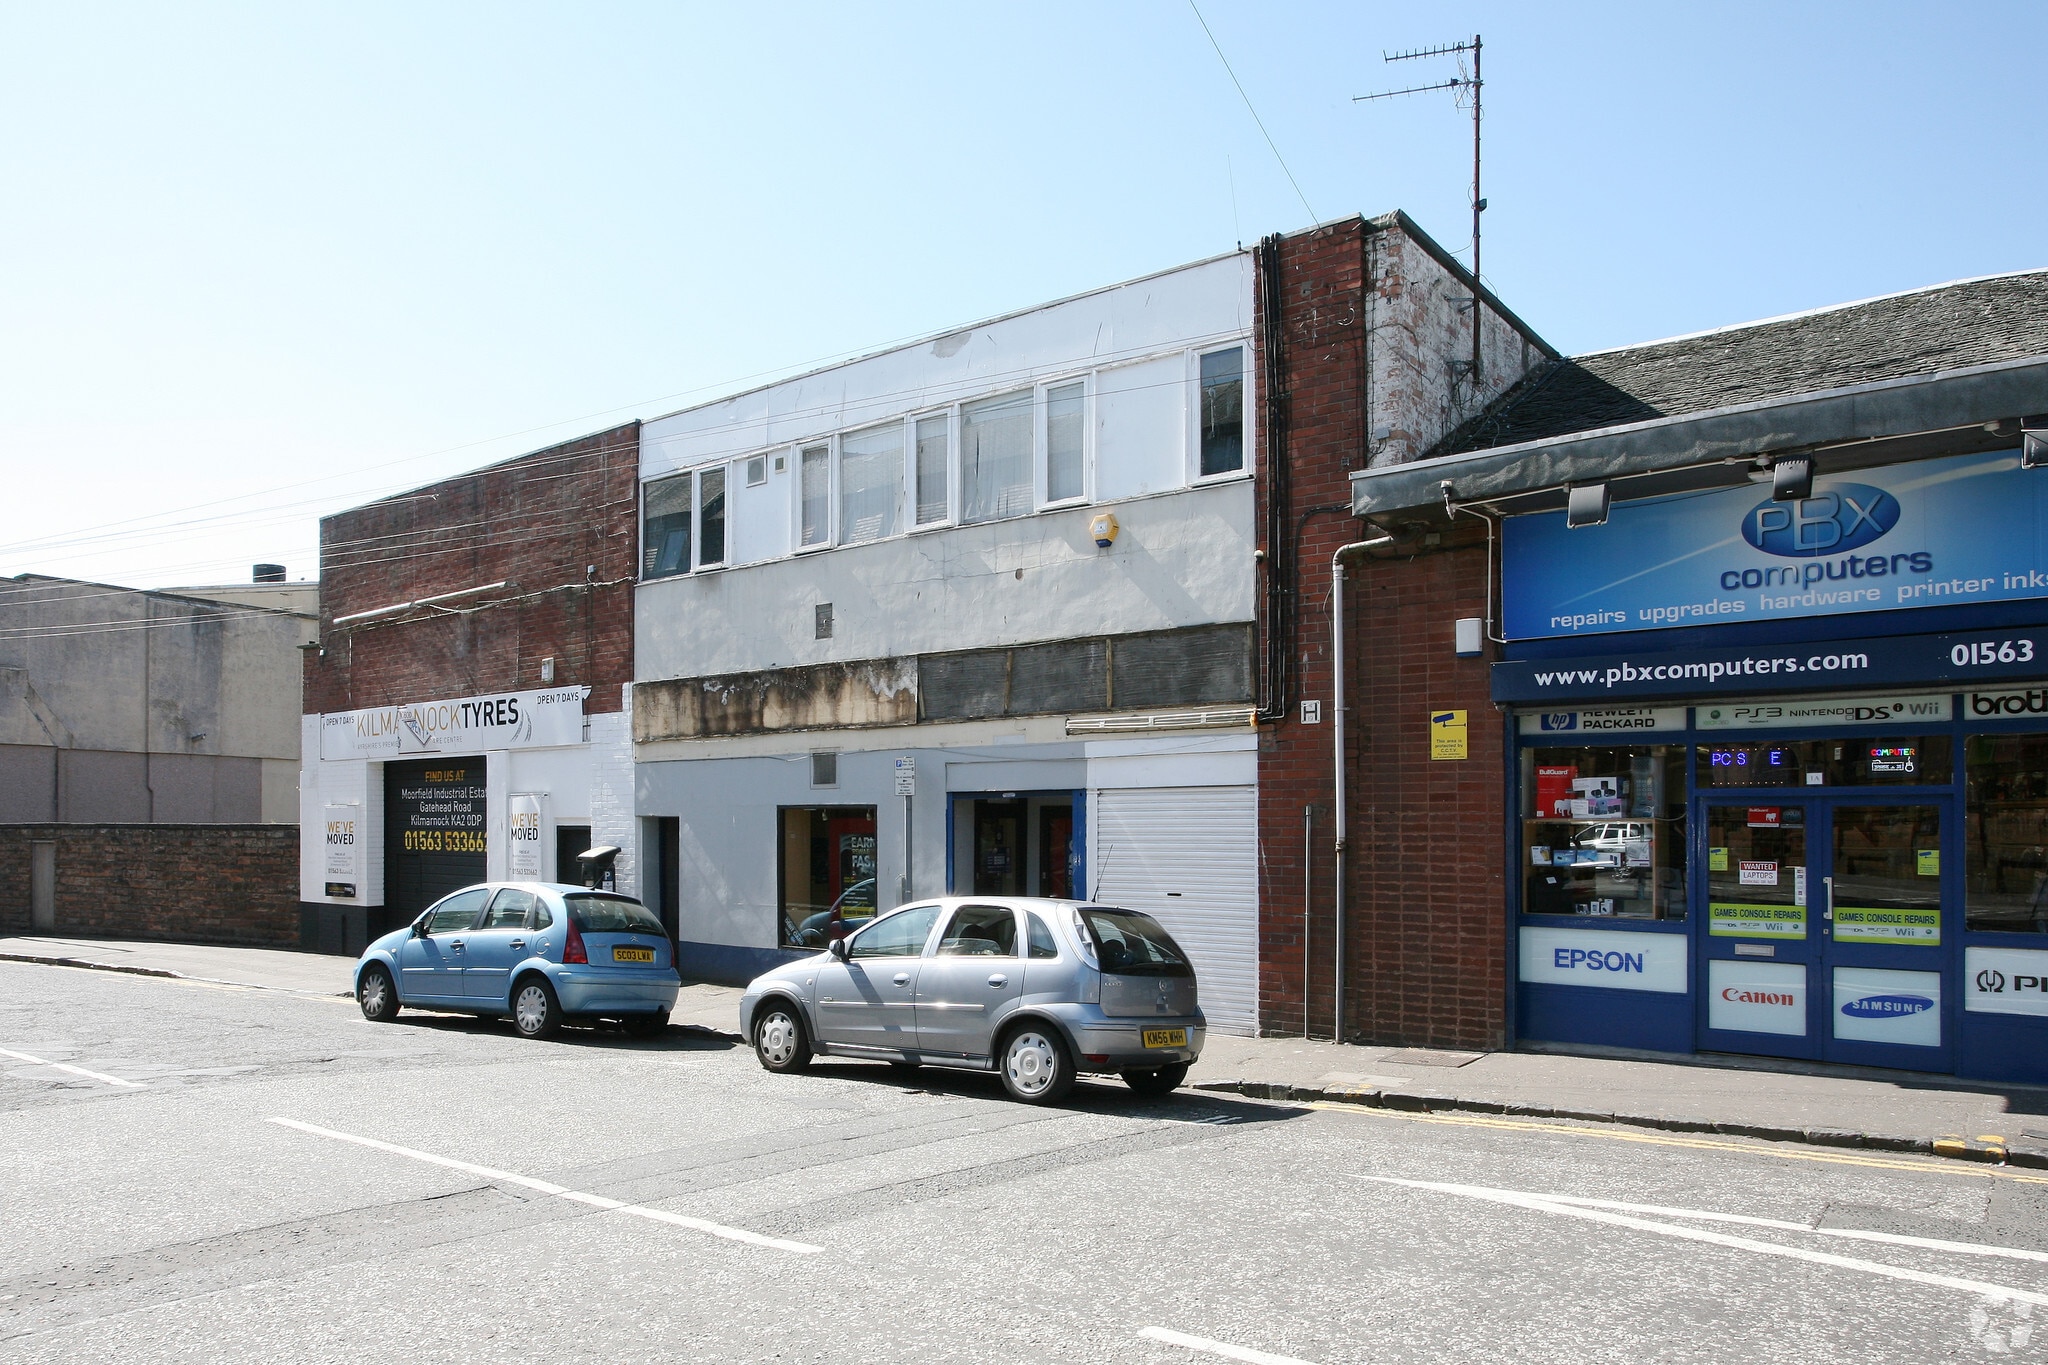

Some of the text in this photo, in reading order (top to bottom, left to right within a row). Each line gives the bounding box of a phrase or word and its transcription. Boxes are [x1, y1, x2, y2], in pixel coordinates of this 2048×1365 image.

[1755, 491, 1884, 552] PBX
[1720, 551, 1933, 592] computers
[1550, 570, 2048, 630] repairs upgrades hardware printer ink
[1534, 639, 2034, 687] www.pbxcomputers.com 01563
[537, 691, 579, 705] OPEN 7 DAYS
[1735, 706, 1783, 719] PS3
[1909, 702, 1940, 716] Wii
[326, 717, 338, 726] OPEN
[1583, 719, 1655, 730] PACKARD
[1871, 748, 1915, 757] COMPUTER
[425, 771, 465, 782] FIND US AT
[401, 788, 432, 800] Moorfield
[434, 787, 467, 799] Industrial
[420, 801, 472, 812] Gatehead Road
[411, 815, 449, 826] Kilmarnock
[451, 815, 466, 826] KA2
[511, 813, 538, 827] WE'VE
[328, 821, 354, 833] WE'VE
[327, 834, 354, 845] MOVED
[511, 828, 538, 840] MOVED
[404, 831, 442, 850] 01563
[1714, 908, 1801, 920] GAMES CONSOLE REPAIRS
[1838, 912, 1935, 924] GAMES CONSOLE REPAIRS
[1765, 922, 1783, 931] Wii
[1895, 927, 1915, 936] Wii
[616, 950, 636, 960] SC03
[1554, 948, 1643, 973] EPSON
[1722, 987, 1793, 1006] Canon
[1851, 999, 1923, 1014] SAMSUNG
[1147, 1030, 1184, 1045] KM56 WHH
